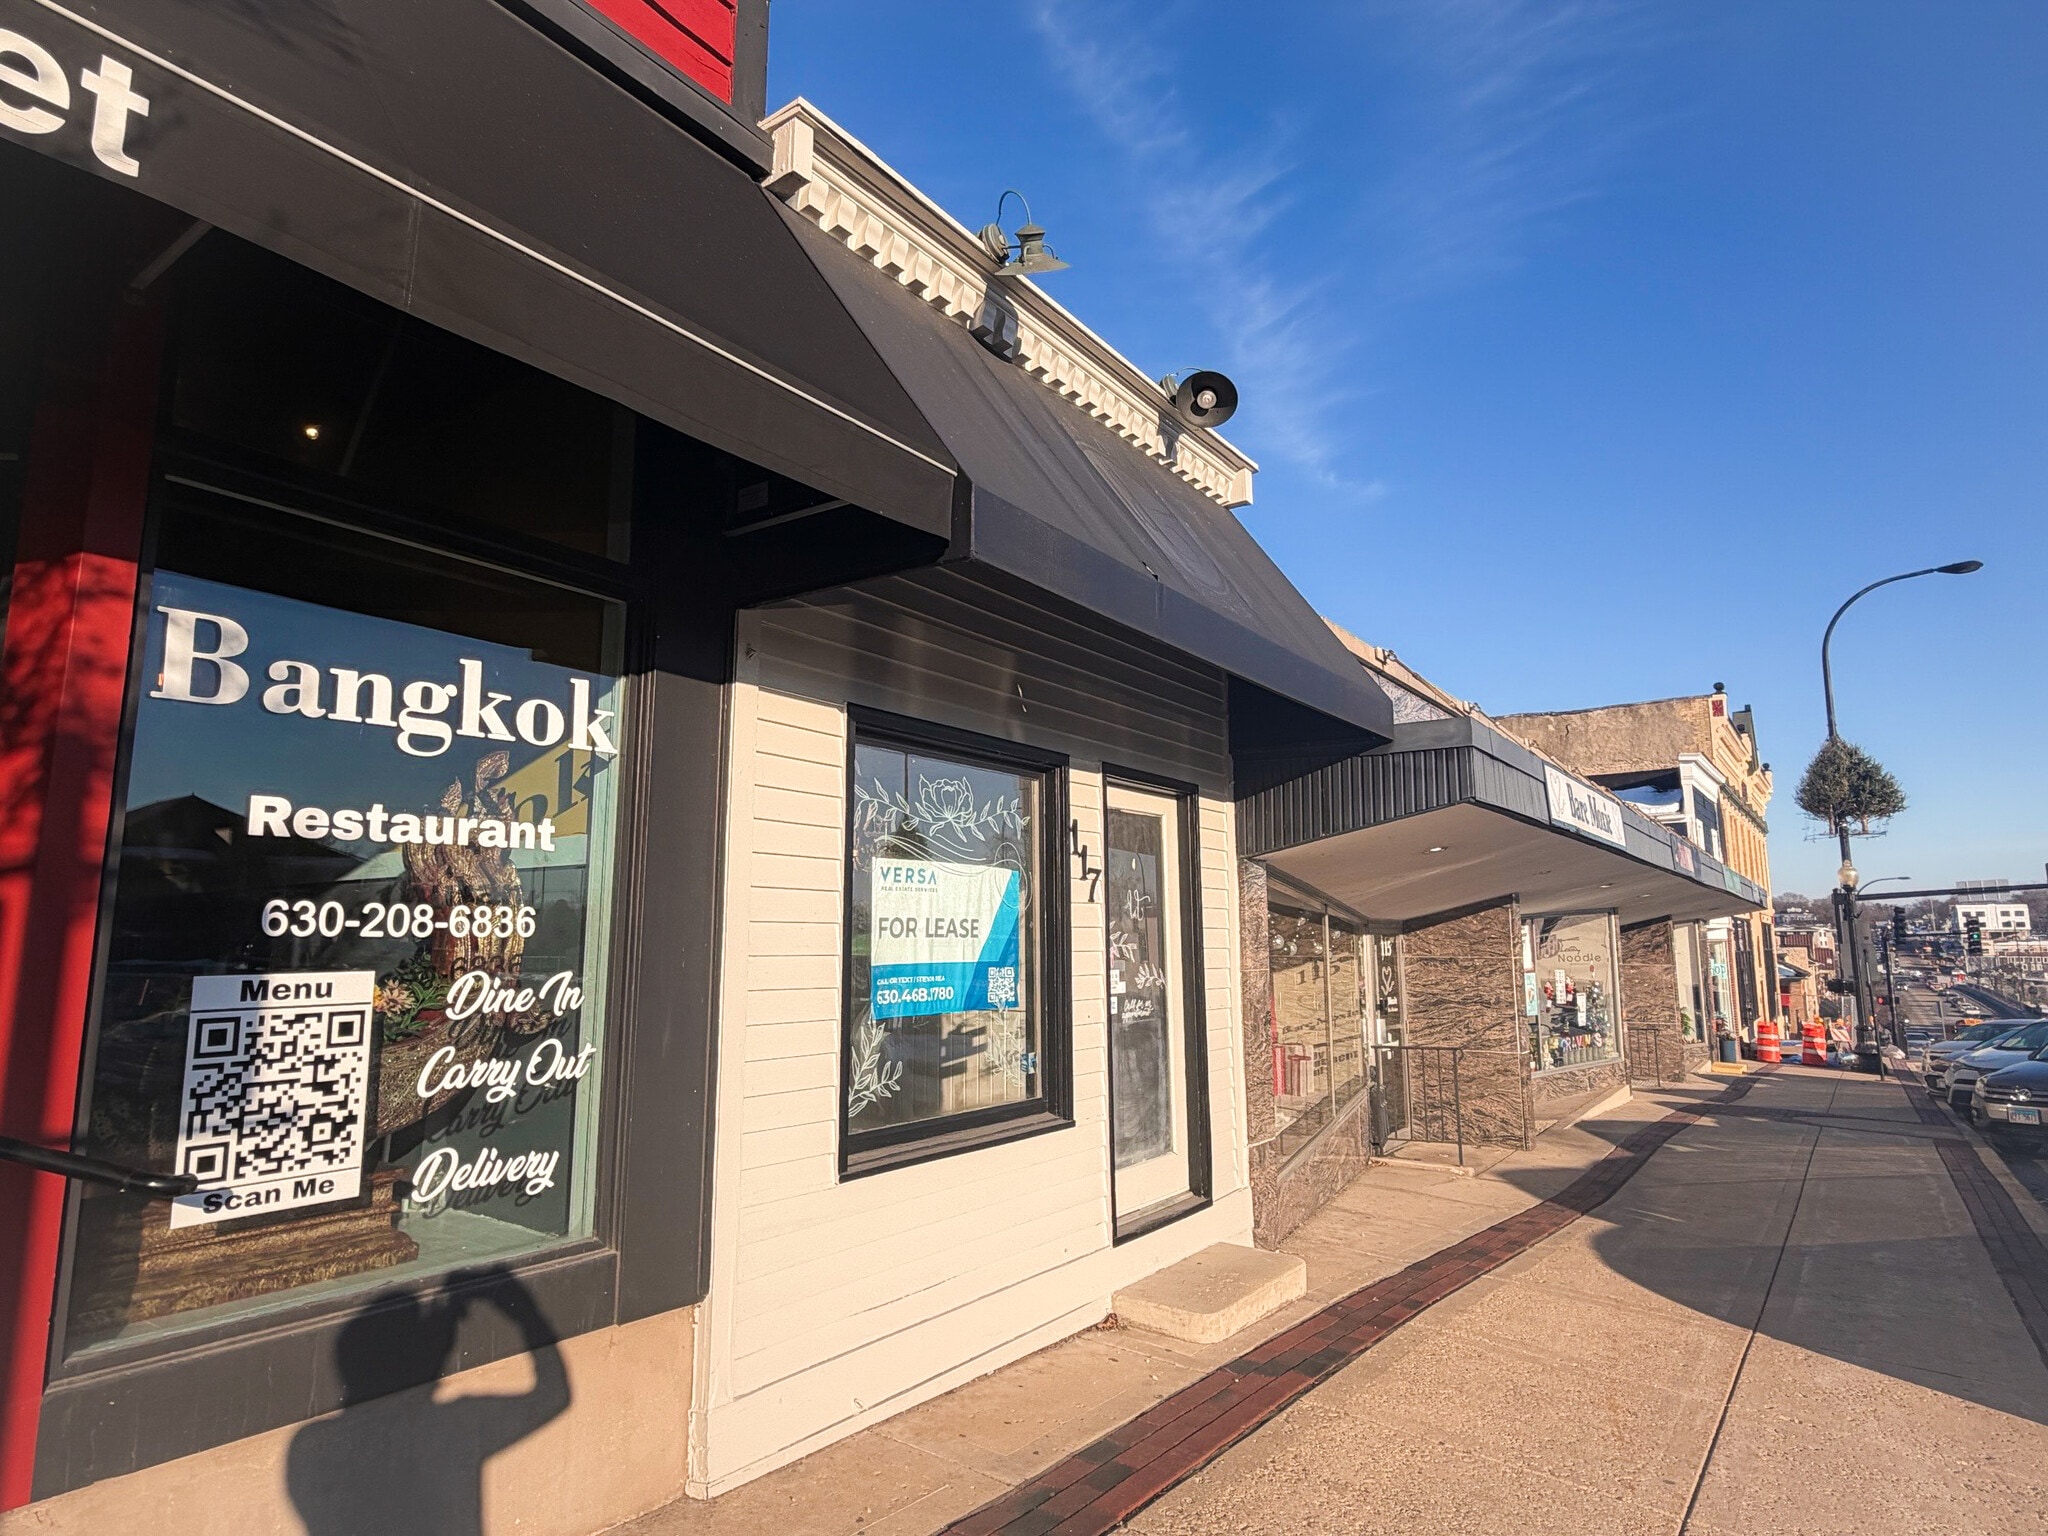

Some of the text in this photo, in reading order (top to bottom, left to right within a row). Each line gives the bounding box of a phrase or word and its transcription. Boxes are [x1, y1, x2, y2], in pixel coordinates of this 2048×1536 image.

[150, 605, 618, 758] Bangkok
[246, 794, 556, 853] Restaurant
[1566, 783, 1590, 825] Bare
[880, 866, 937, 885] VERSA
[261, 899, 537, 938] 630-208-6836
[878, 917, 980, 939] FOR LEASE
[1557, 953, 1602, 963] Noodle
[240, 979, 334, 1002] Menu
[445, 970, 586, 1021] Dine In
[877, 986, 954, 1004] 630.468.1780
[416, 1038, 597, 1104] Carry Out
[410, 1146, 560, 1203] Delivery
[202, 1177, 336, 1215] Scan Me
